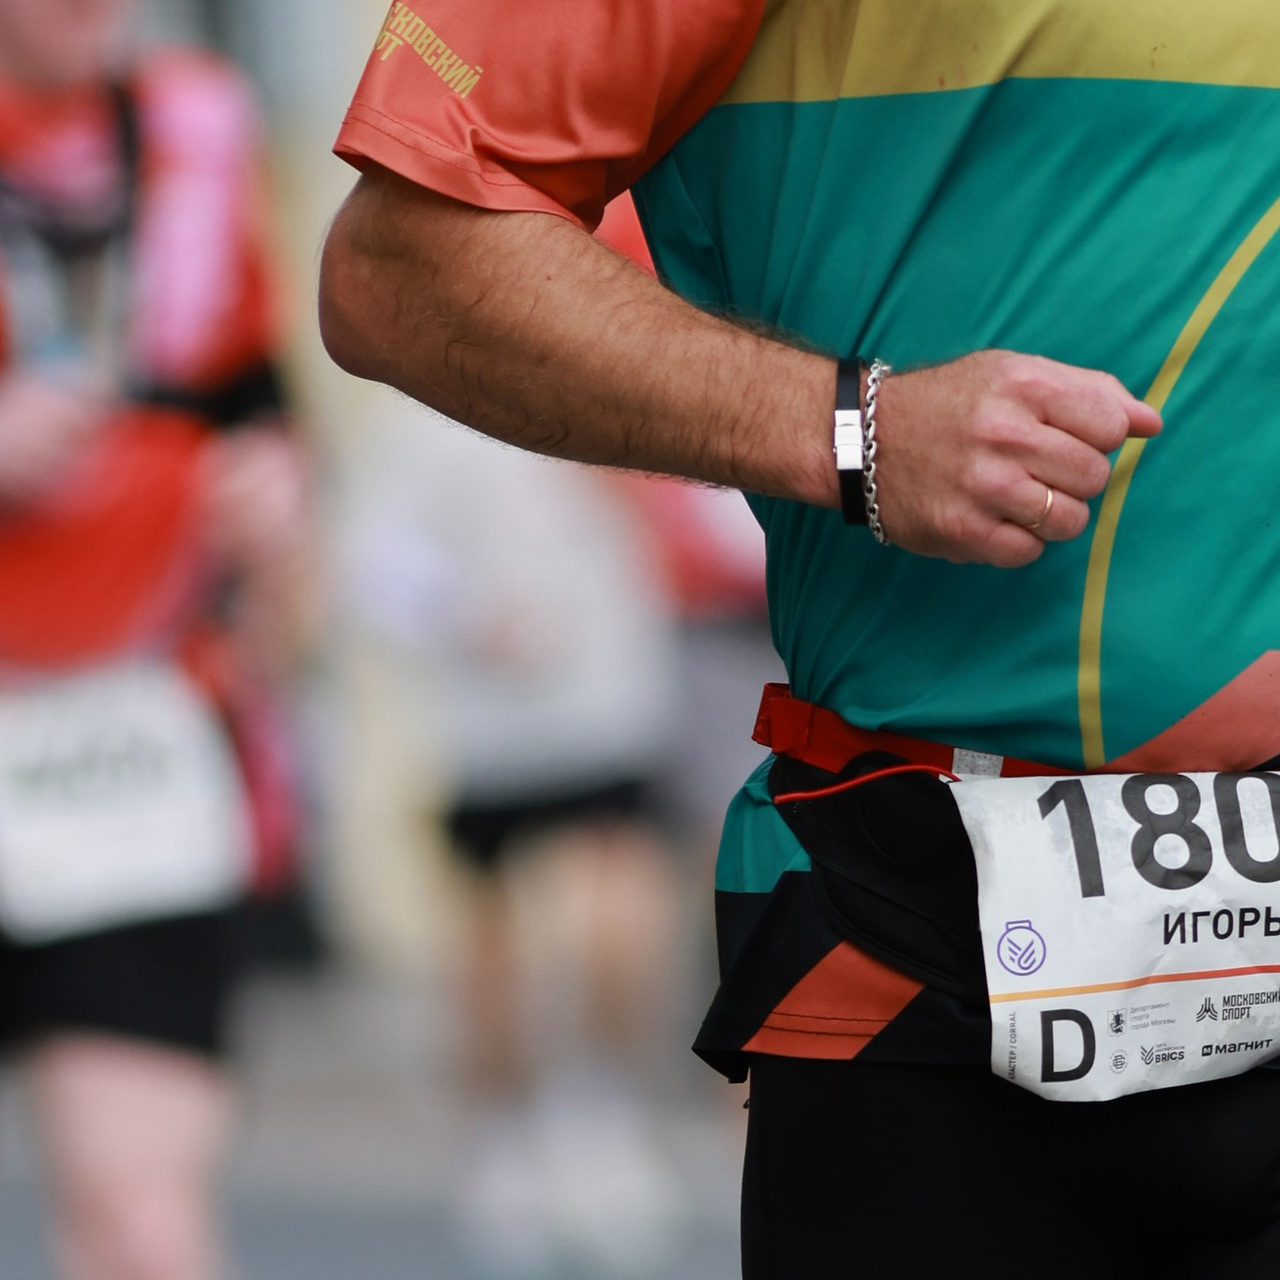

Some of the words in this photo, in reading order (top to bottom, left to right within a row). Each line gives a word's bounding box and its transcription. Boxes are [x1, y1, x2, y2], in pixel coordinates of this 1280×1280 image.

[1221, 1006, 1253, 1021] СПОРТ
[1008, 1010, 1017, 1044] CORRAL
[1040, 1008, 1096, 1083] D
[1155, 1051, 1185, 1064] BRICS
